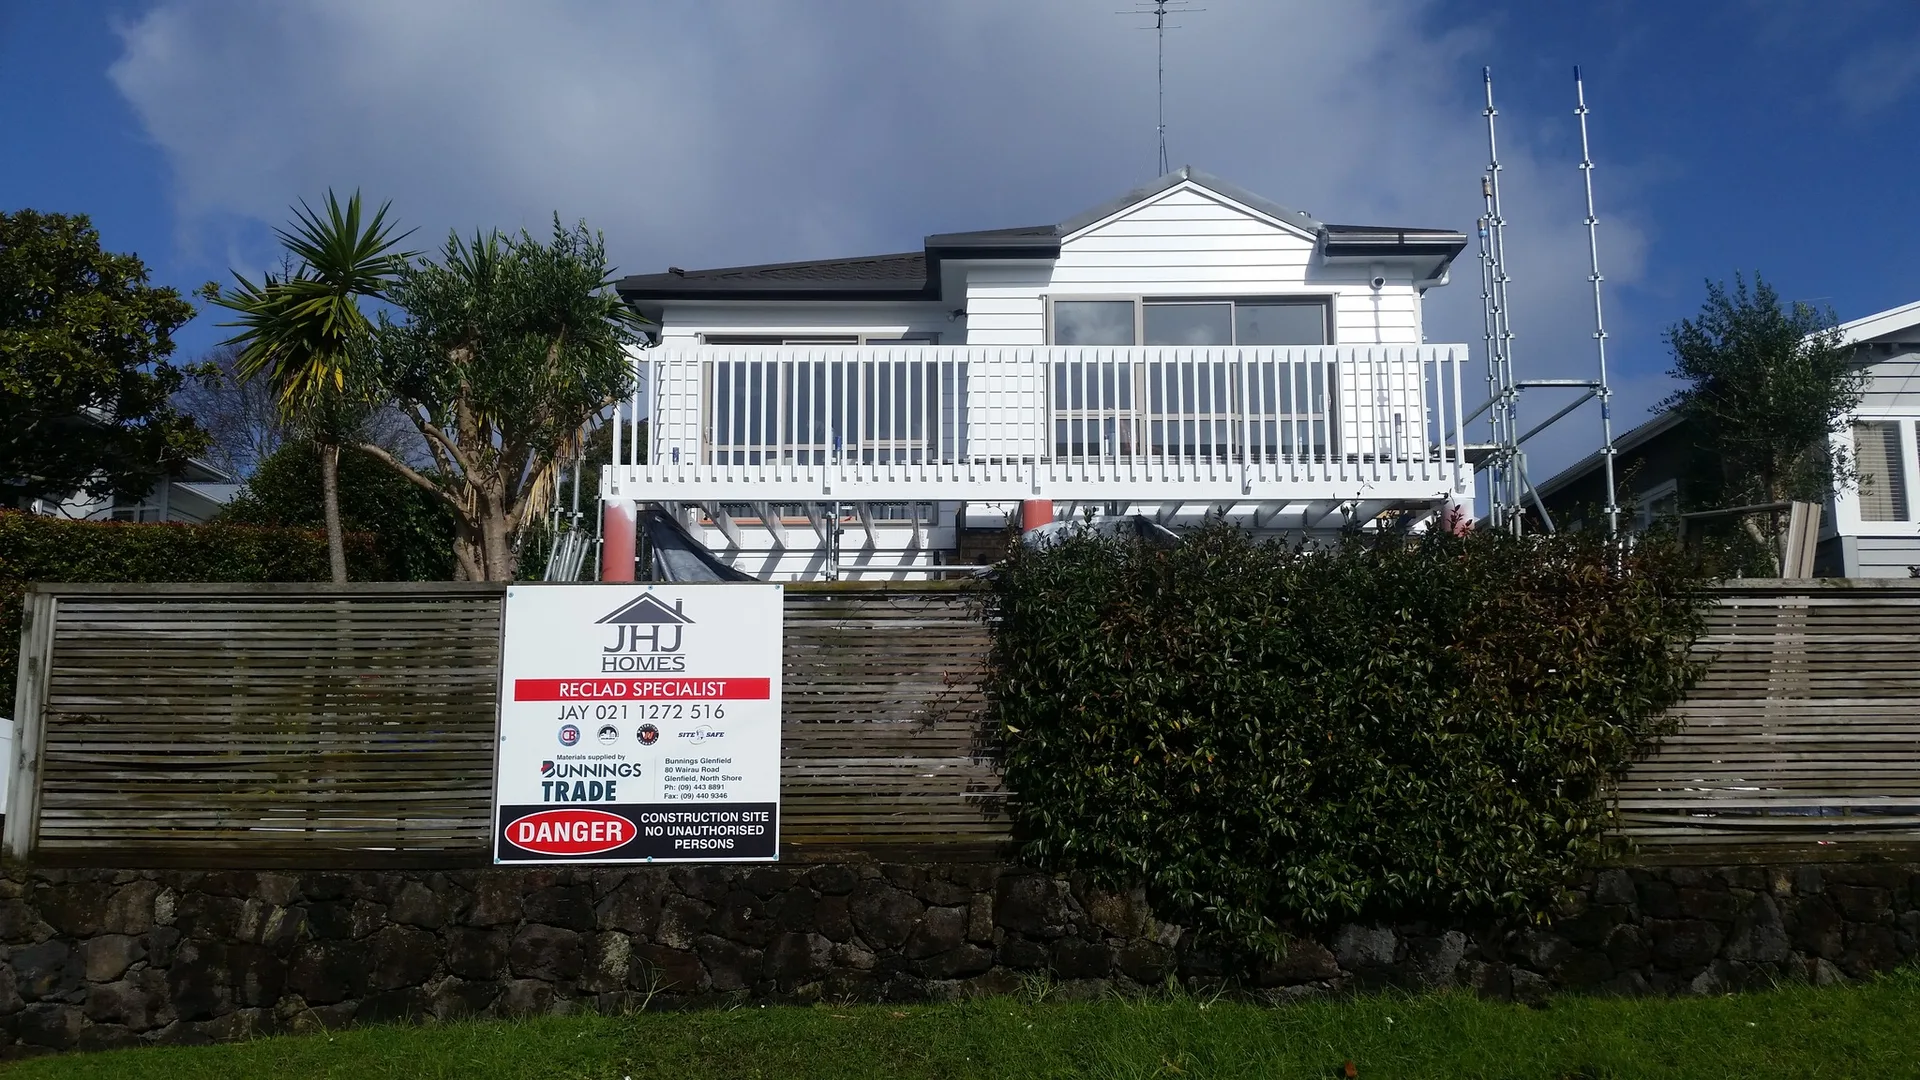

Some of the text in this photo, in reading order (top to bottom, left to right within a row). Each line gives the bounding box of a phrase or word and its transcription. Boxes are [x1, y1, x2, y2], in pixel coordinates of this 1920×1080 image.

[603, 624, 683, 653] JHJ
[602, 656, 686, 671] HOMES
[559, 681, 727, 697] RECLAD SPECIALIST
[557, 704, 725, 720] JAY 021 1272 516
[587, 754, 617, 762] supplied
[665, 757, 699, 766] Bunnings
[541, 760, 642, 778] BUNNINGS
[721, 774, 743, 782] Shore
[541, 780, 617, 802] TRADE
[677, 784, 692, 792] (09)
[680, 793, 695, 801] (09)
[710, 792, 728, 800] 9346
[640, 811, 770, 824] CONSTRUCTION SITE
[518, 821, 623, 843] DANGER
[645, 825, 765, 837] NO UNAUTHORISED
[674, 839, 735, 850] PERSONS
